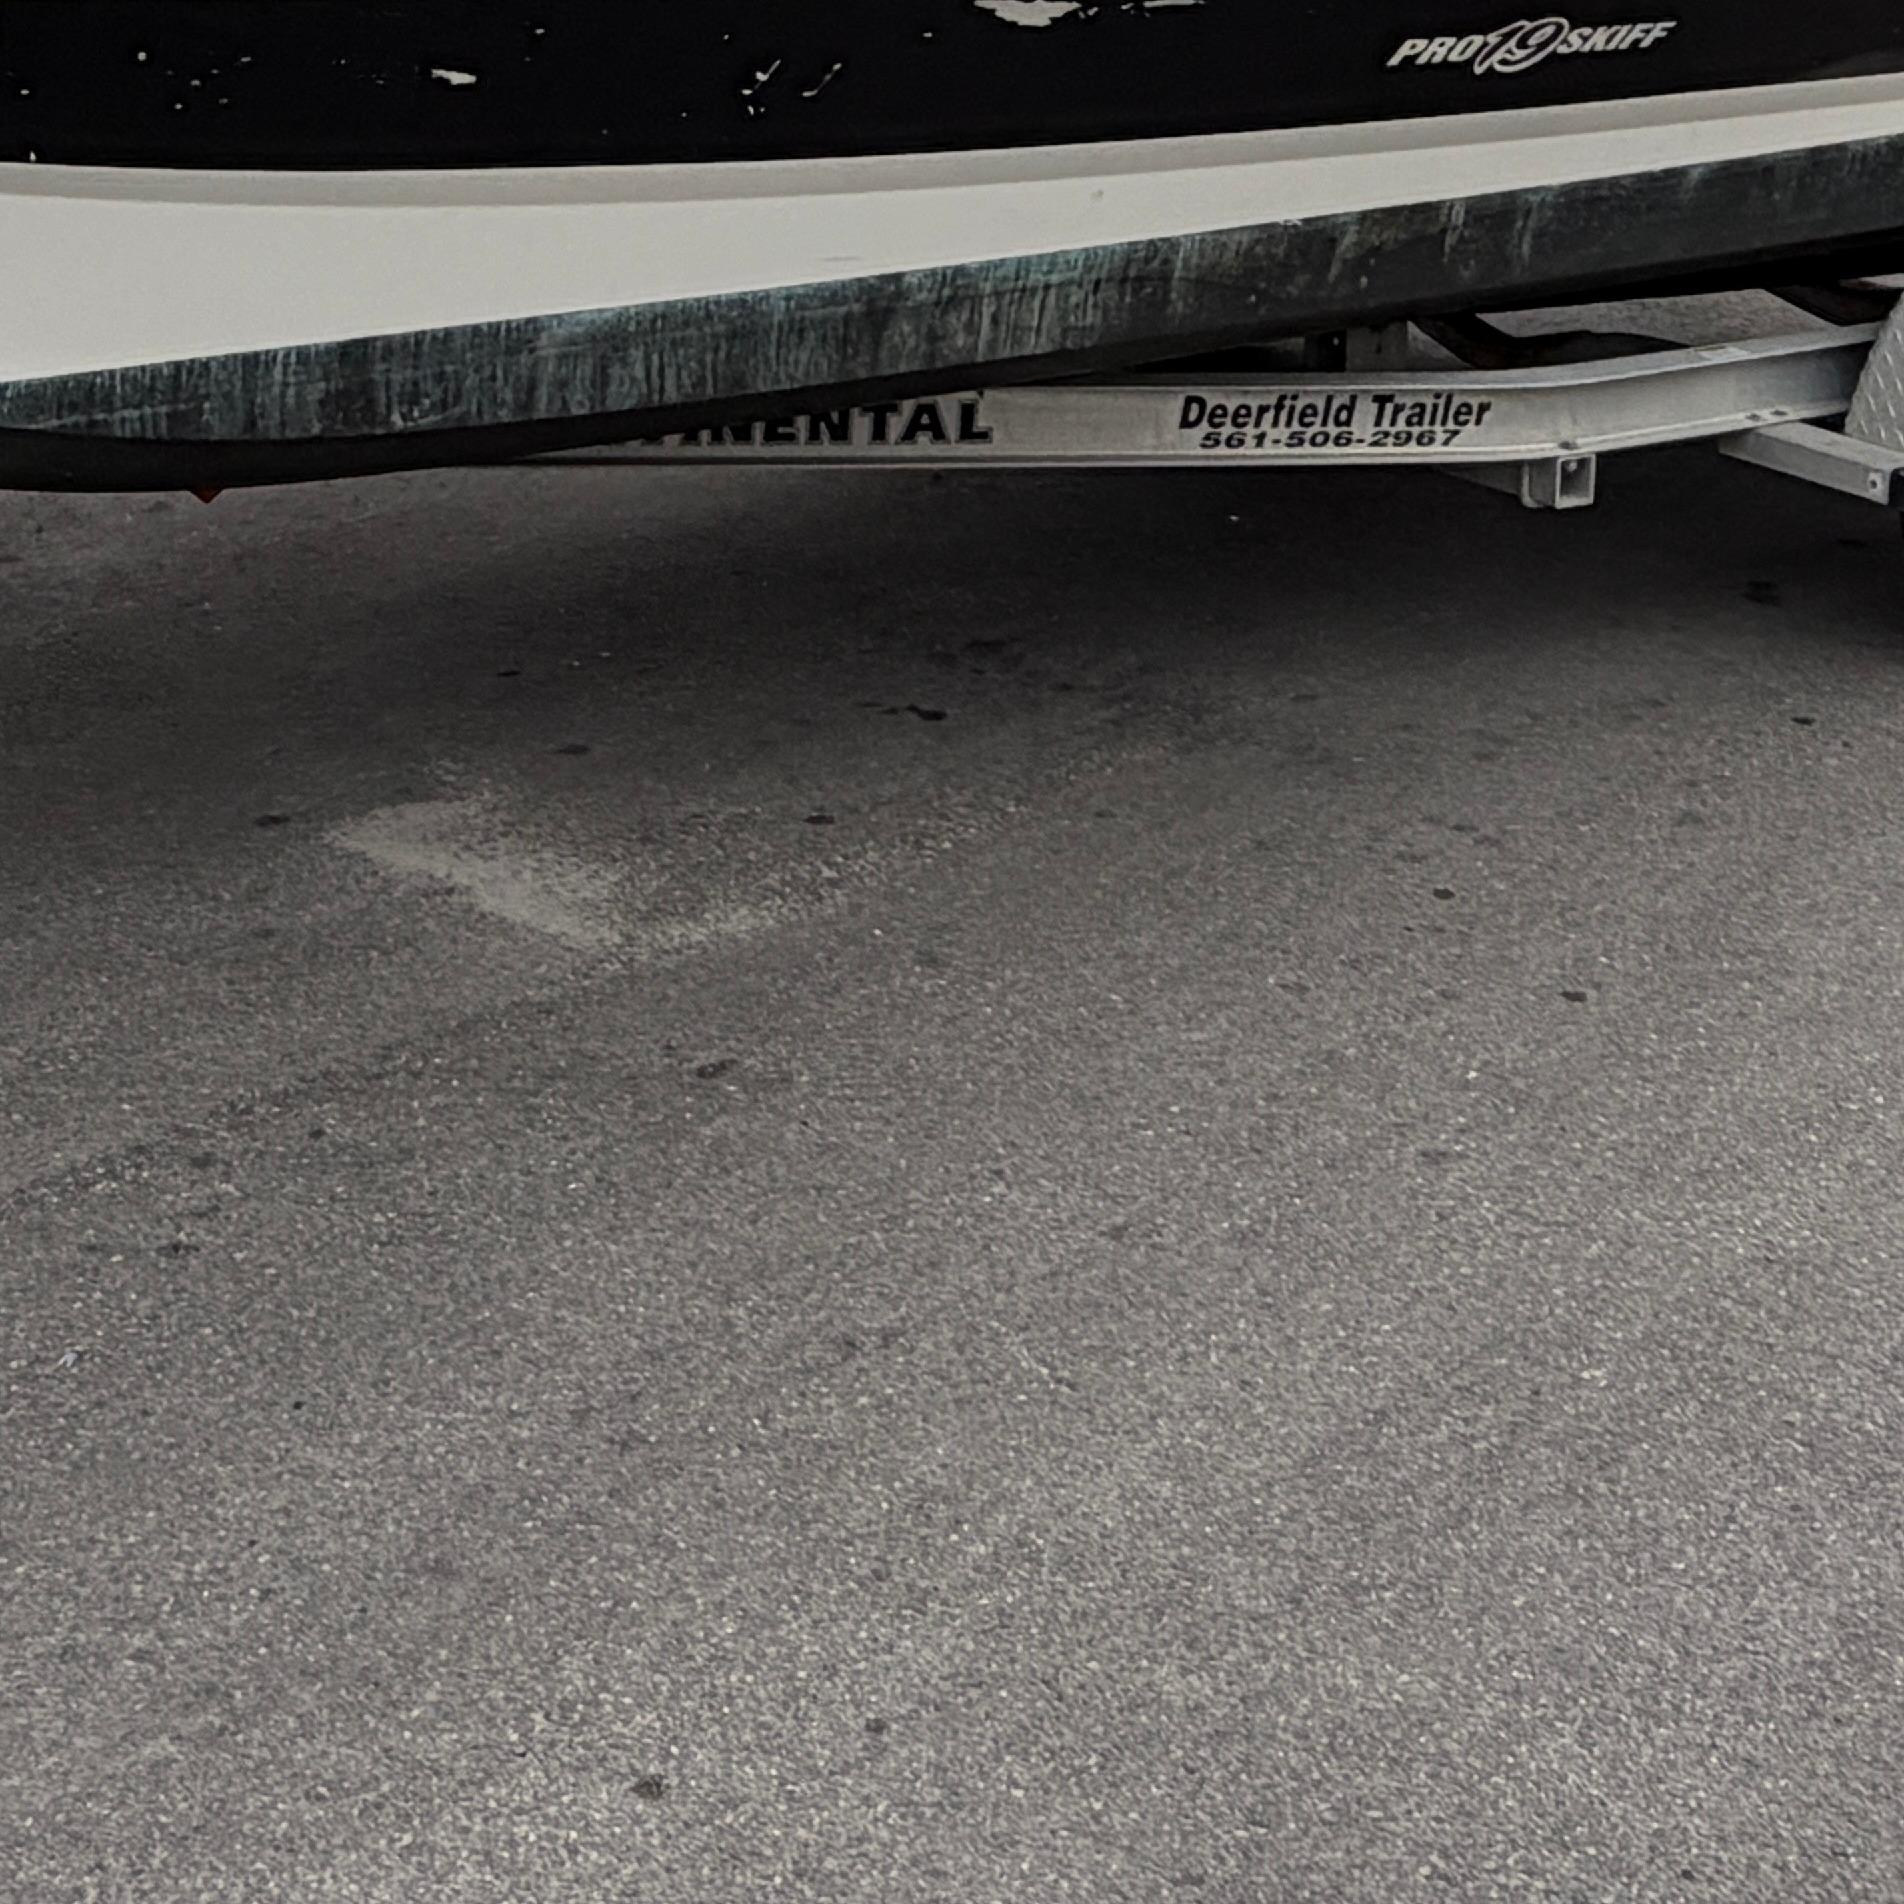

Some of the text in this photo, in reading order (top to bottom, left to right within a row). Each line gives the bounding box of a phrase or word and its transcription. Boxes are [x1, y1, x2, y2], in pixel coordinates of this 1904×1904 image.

[1385, 34, 1483, 68] PRO
[1557, 20, 1677, 54] SKIFF
[1179, 393, 1493, 429] Deerfield Trailer
[1199, 430, 1462, 449] 561-506-2967
